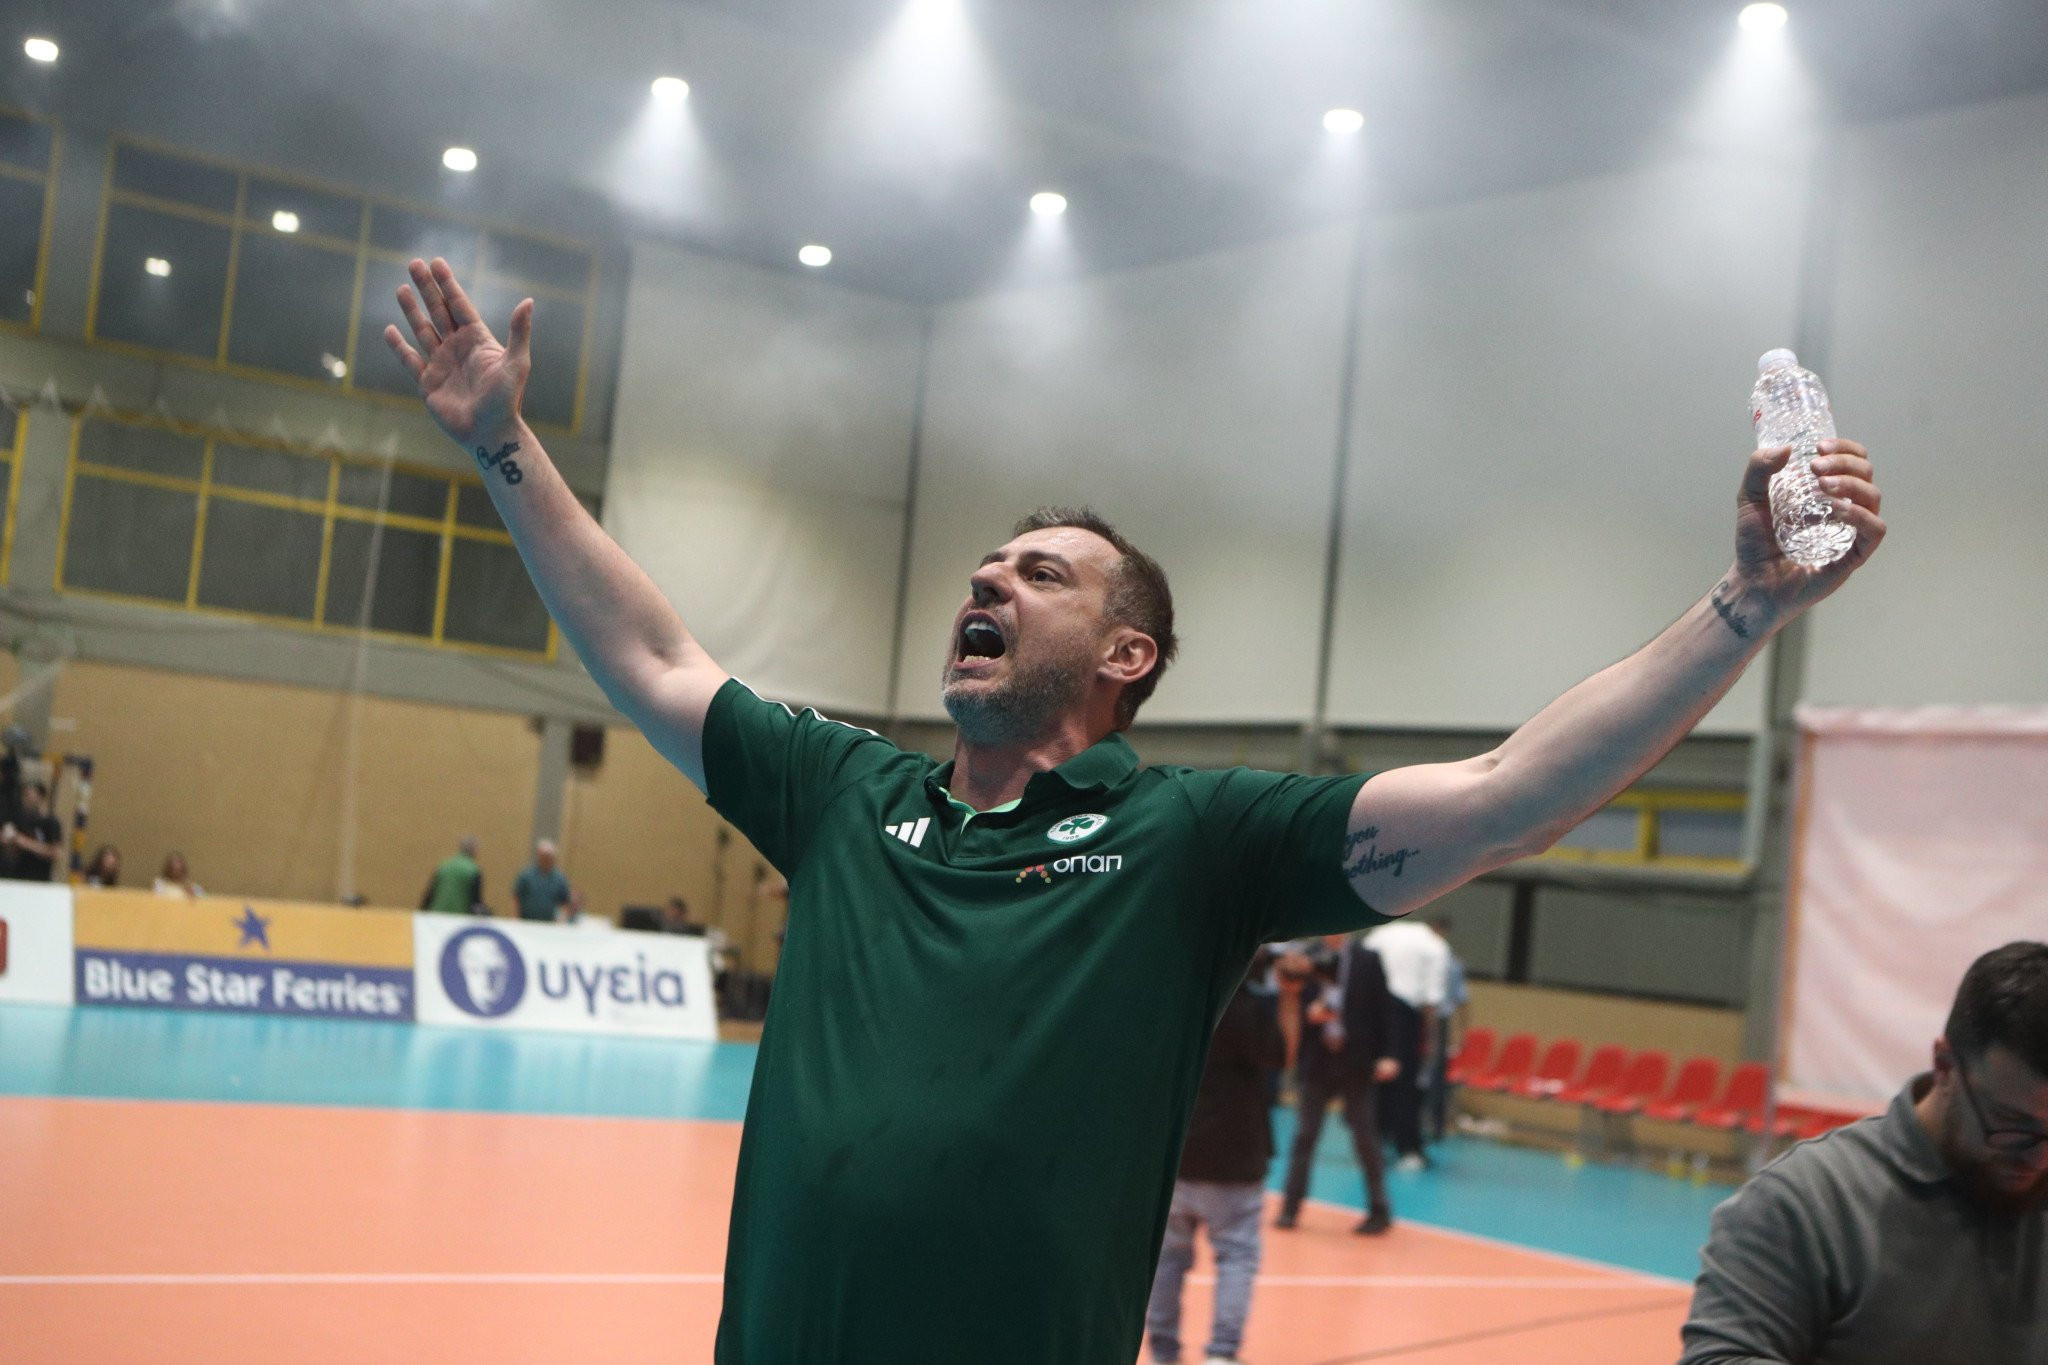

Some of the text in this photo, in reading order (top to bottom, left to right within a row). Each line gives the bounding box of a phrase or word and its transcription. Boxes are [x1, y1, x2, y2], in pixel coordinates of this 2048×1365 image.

[83, 957, 401, 1015] Blue Star Ferries
